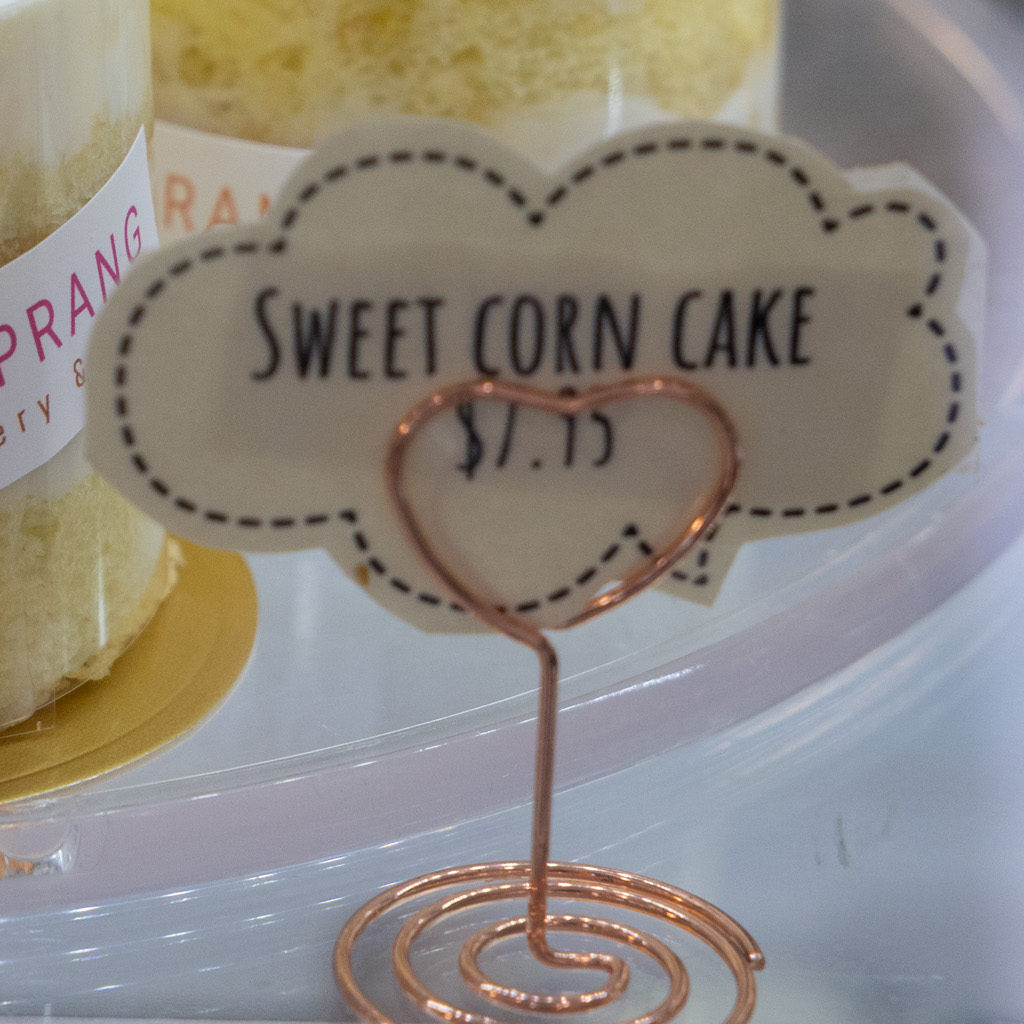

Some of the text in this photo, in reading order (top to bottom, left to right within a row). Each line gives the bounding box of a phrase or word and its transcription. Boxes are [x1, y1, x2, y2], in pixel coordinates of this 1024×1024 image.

[162, 172, 271, 232] RA
[472, 292, 641, 378] CORN
[672, 287, 816, 371] CAKE
